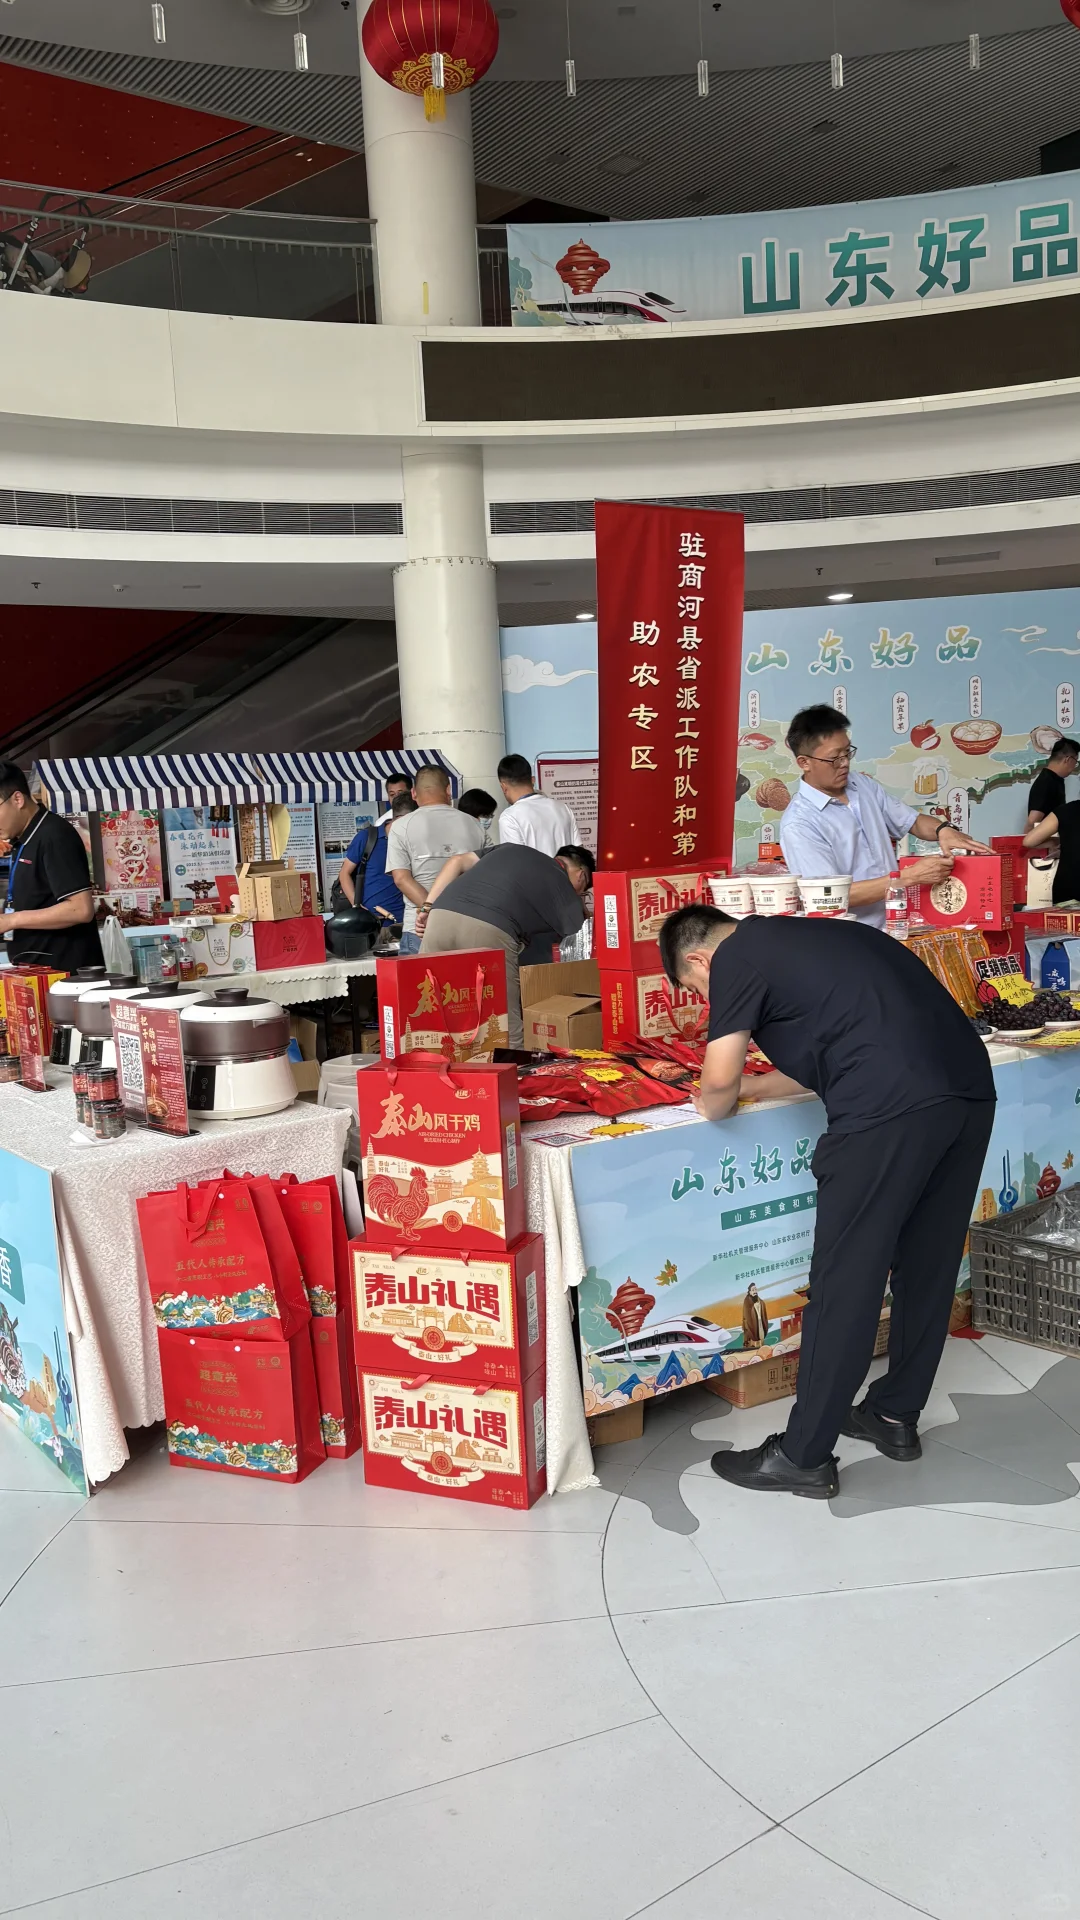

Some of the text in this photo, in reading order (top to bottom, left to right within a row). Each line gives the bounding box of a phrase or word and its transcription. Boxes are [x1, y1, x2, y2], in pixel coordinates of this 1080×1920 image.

[741, 202, 1079, 315] 山东好品
[747, 627, 981, 675] 山东好品
[628, 620, 660, 770] 助农专区
[672, 532, 706, 857] 驻商河县省派工作队和第
[975, 954, 1022, 979] 促销商品
[140, 1014, 150, 1054] 把子肉
[148, 1027, 159, 1066] 的由来
[370, 1090, 481, 1139] 泰山风干鸡
[734, 1195, 814, 1223] 山东美食和特
[175, 1253, 245, 1272] 五代人传承配方
[712, 1229, 811, 1262] 新华社机关管理服务中心 山东省农业农村厅
[734, 1255, 805, 1281] 新华社机关管理服务中心餐饮处
[364, 1272, 500, 1323] 泰山礼遇
[185, 1398, 264, 1420] 五代人传承配方
[374, 1395, 508, 1450] 泰山礼遇
